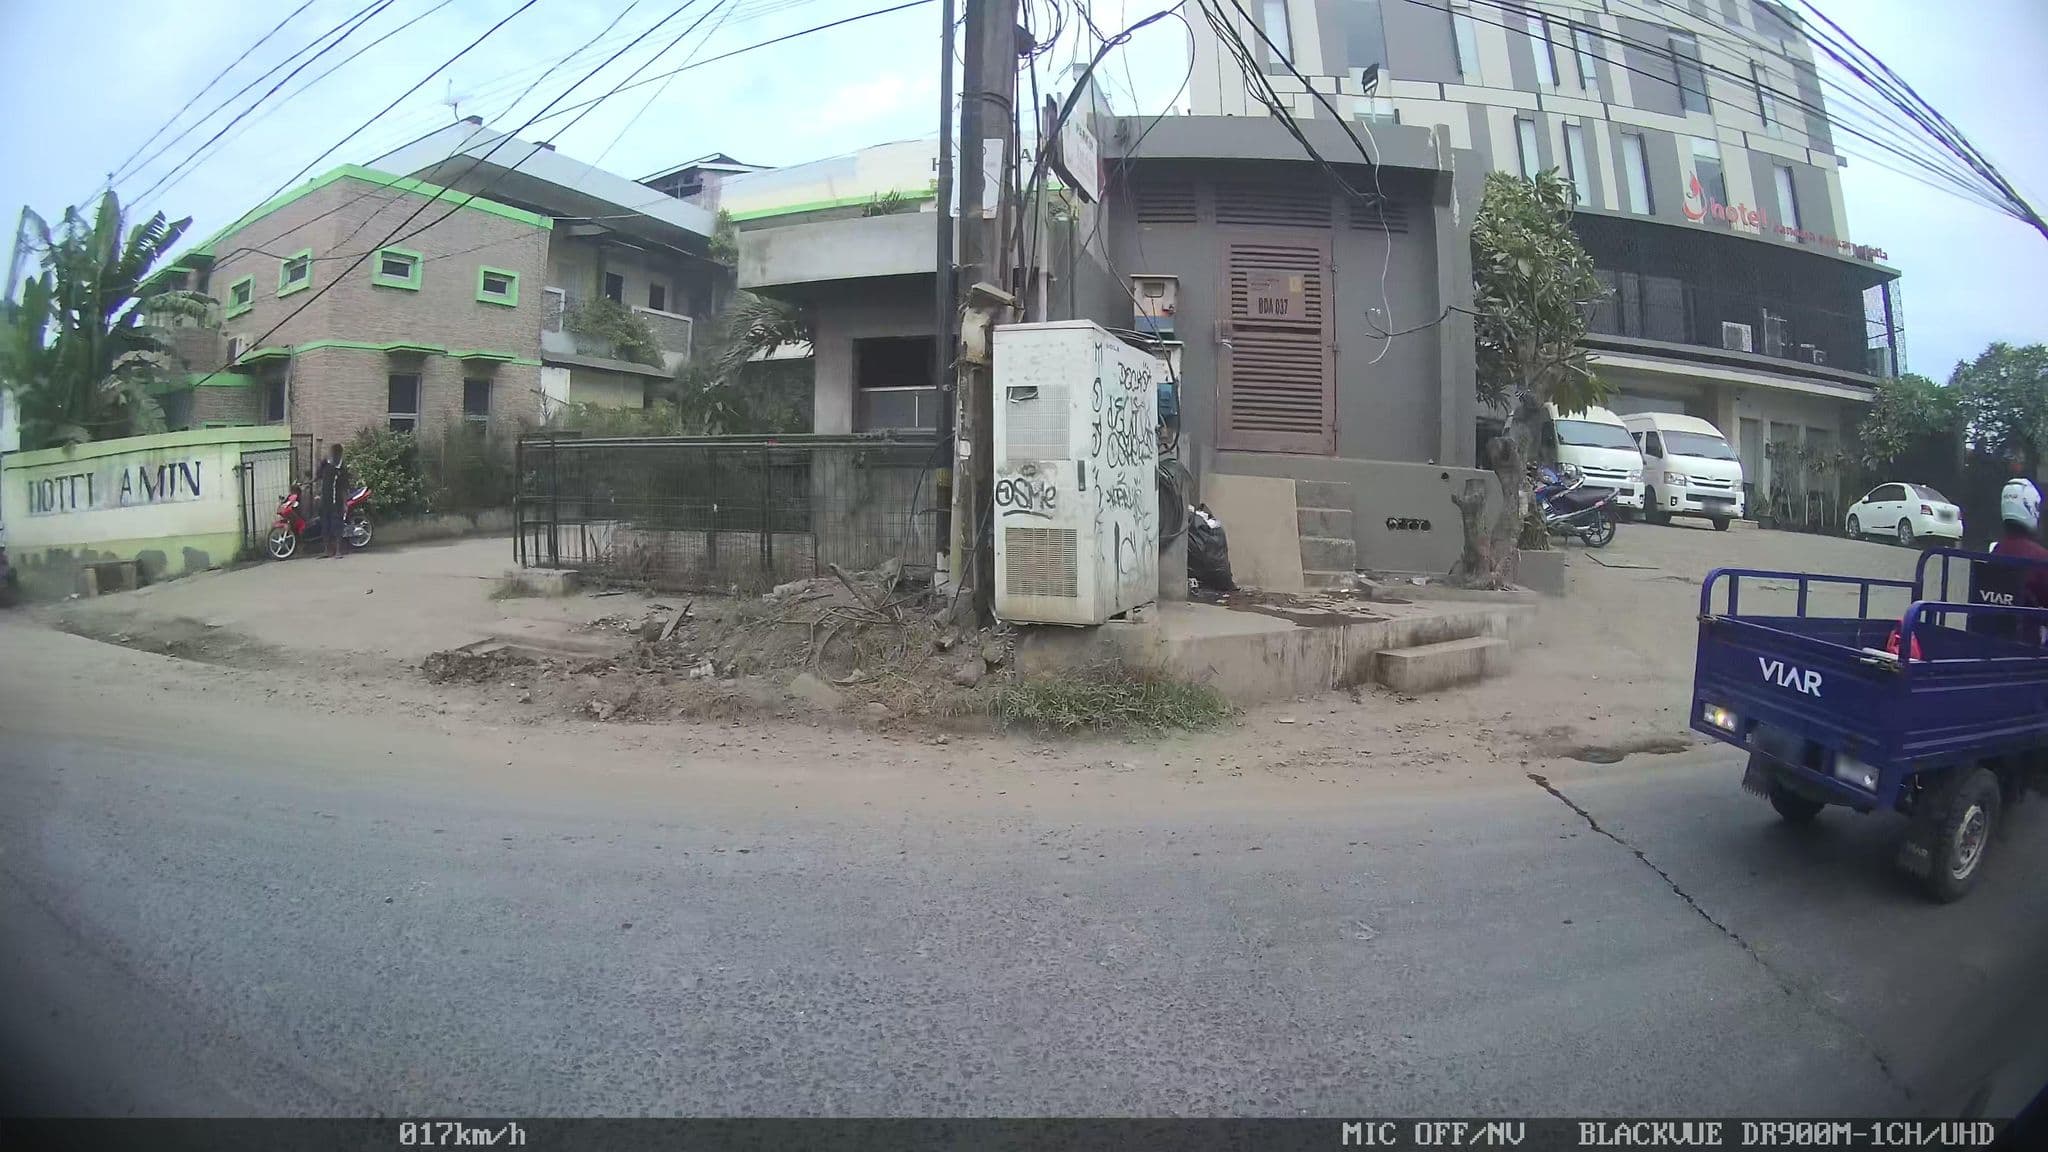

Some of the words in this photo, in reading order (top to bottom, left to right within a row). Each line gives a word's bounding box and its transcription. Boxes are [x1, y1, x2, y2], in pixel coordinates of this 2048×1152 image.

[1710, 197, 1767, 227] hotel
[1275, 298, 1288, 315] 037
[119, 461, 201, 506] AMIN
[1979, 590, 2014, 606] VIAR
[1758, 656, 1823, 698] VIAR
